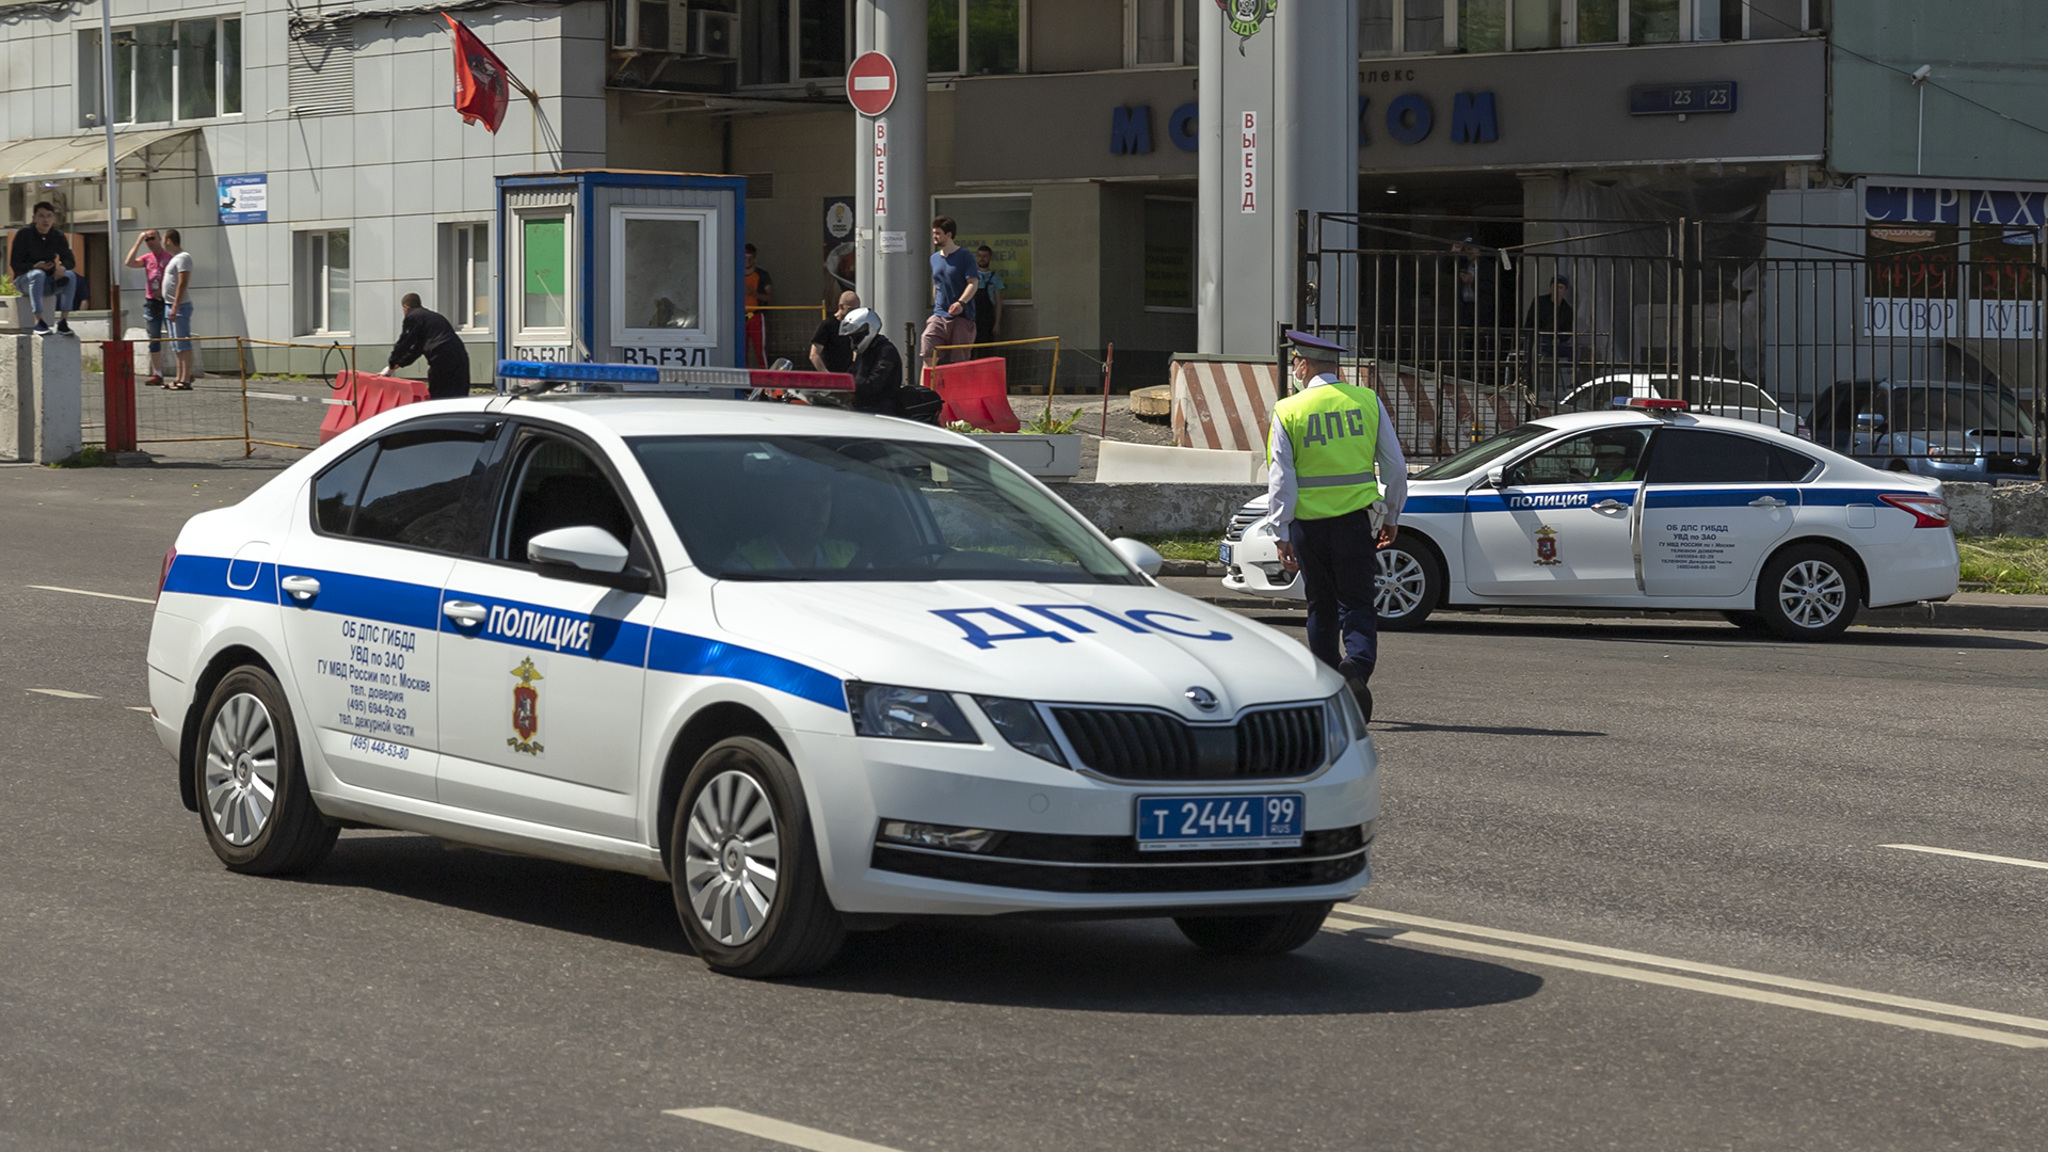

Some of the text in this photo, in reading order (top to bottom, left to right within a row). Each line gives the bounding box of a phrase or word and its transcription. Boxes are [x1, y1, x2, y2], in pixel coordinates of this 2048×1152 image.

[1674, 90, 1692, 105] 23
[1709, 89, 1728, 105] 23
[875, 125, 887, 215] ВЫЕЗД
[1242, 113, 1256, 211] ВЫЕЗД
[1303, 409, 1364, 448] ДПС
[1509, 493, 1589, 508] ПОЛИЦИЯ
[1673, 533, 1689, 541] УВД
[1701, 533, 1717, 541] ЗАО
[1680, 524, 1698, 532] ДПС
[1700, 524, 1729, 533] ГИБДД
[342, 620, 416, 653] ОБ ДПС ГИБДД
[487, 605, 596, 651] ПОЛИЦИЯ
[927, 603, 1234, 650] ДПС
[350, 644, 405, 670] УВД по ЗАО
[317, 659, 328, 675] ГУ
[329, 661, 348, 681] МВД
[349, 664, 378, 683] России
[380, 673, 391, 686] по
[399, 673, 431, 693] Москве
[350, 684, 404, 704] тел. доверия
[347, 698, 407, 720] (495) 694-92-29
[338, 713, 415, 738] тел. дежурной части
[350, 736, 410, 761] (495) 448-53-80
[1153, 798, 1295, 835] Т 2444 99
[1270, 824, 1291, 834] RUS
